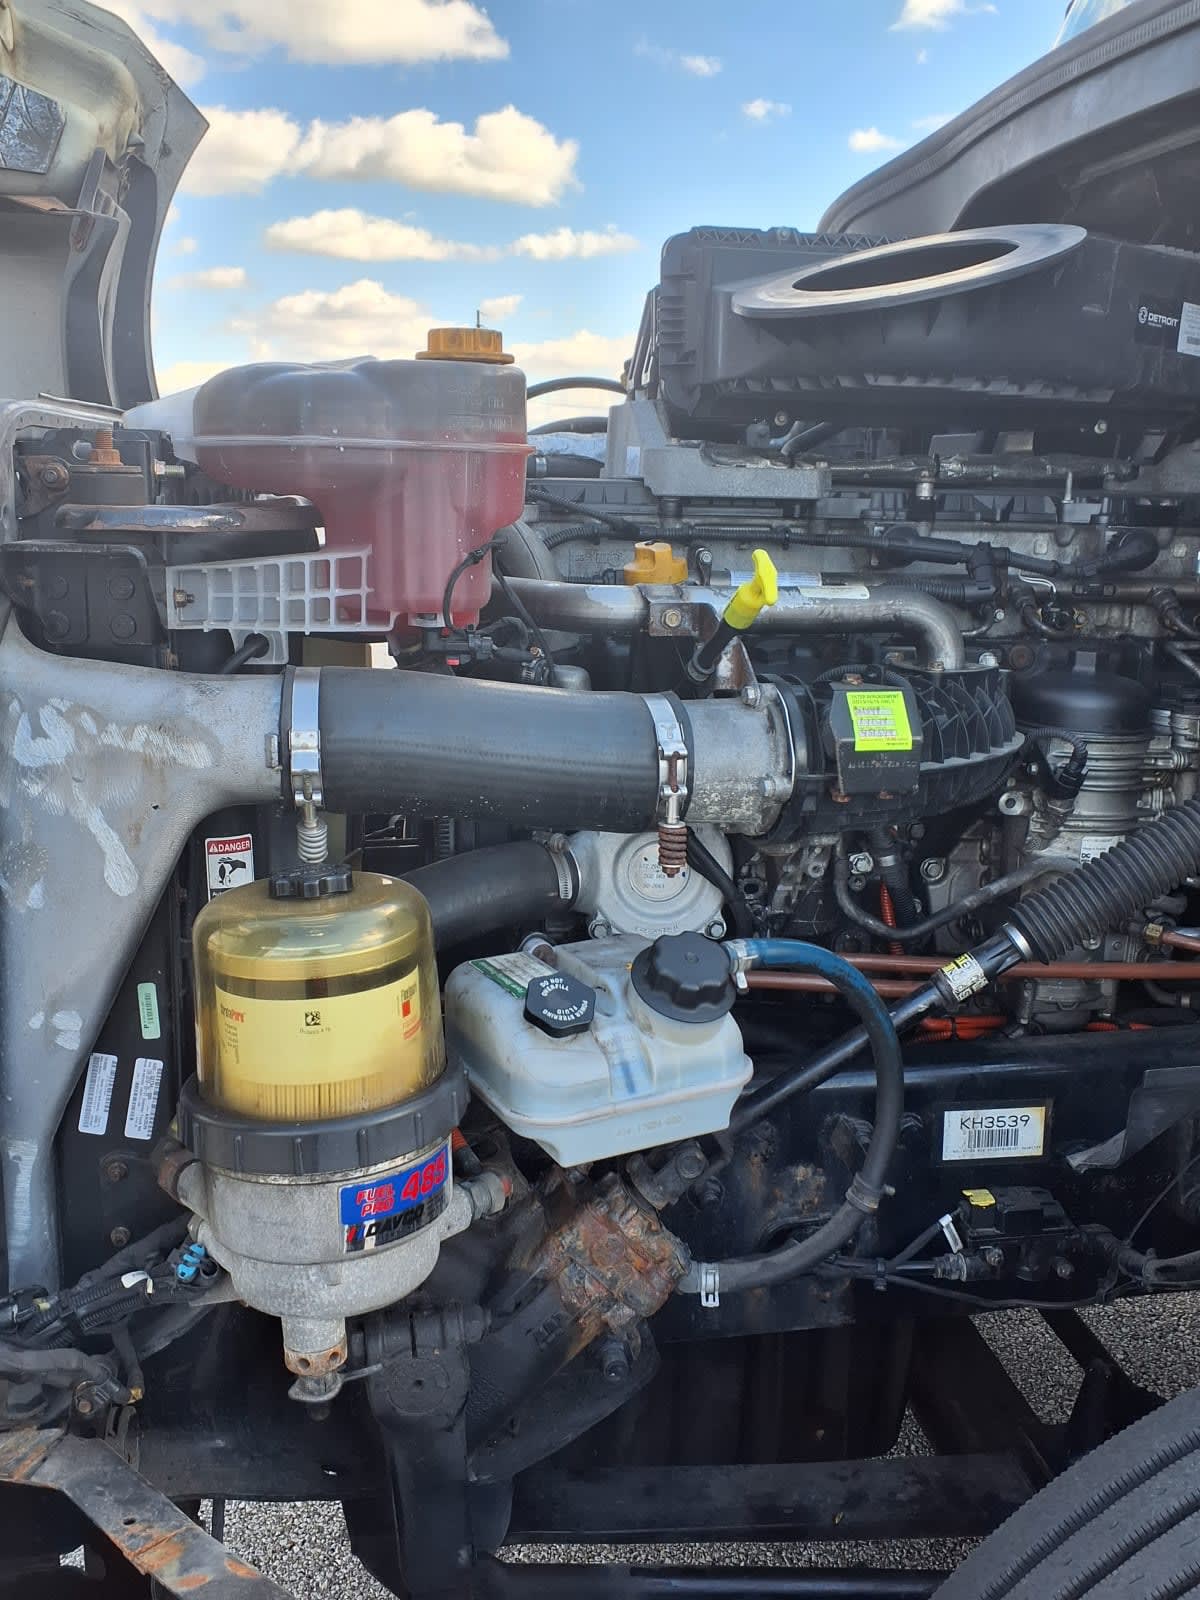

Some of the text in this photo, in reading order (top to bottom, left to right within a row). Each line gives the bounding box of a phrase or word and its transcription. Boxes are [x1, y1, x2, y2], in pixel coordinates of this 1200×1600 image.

[1148, 313, 1179, 327] DETROIT
[218, 841, 250, 853] DANGER
[960, 1114, 1031, 1130] KH3539
[356, 1183, 394, 1205] FUEL
[361, 1198, 394, 1217] PRO
[364, 1202, 425, 1238] DAVCO
